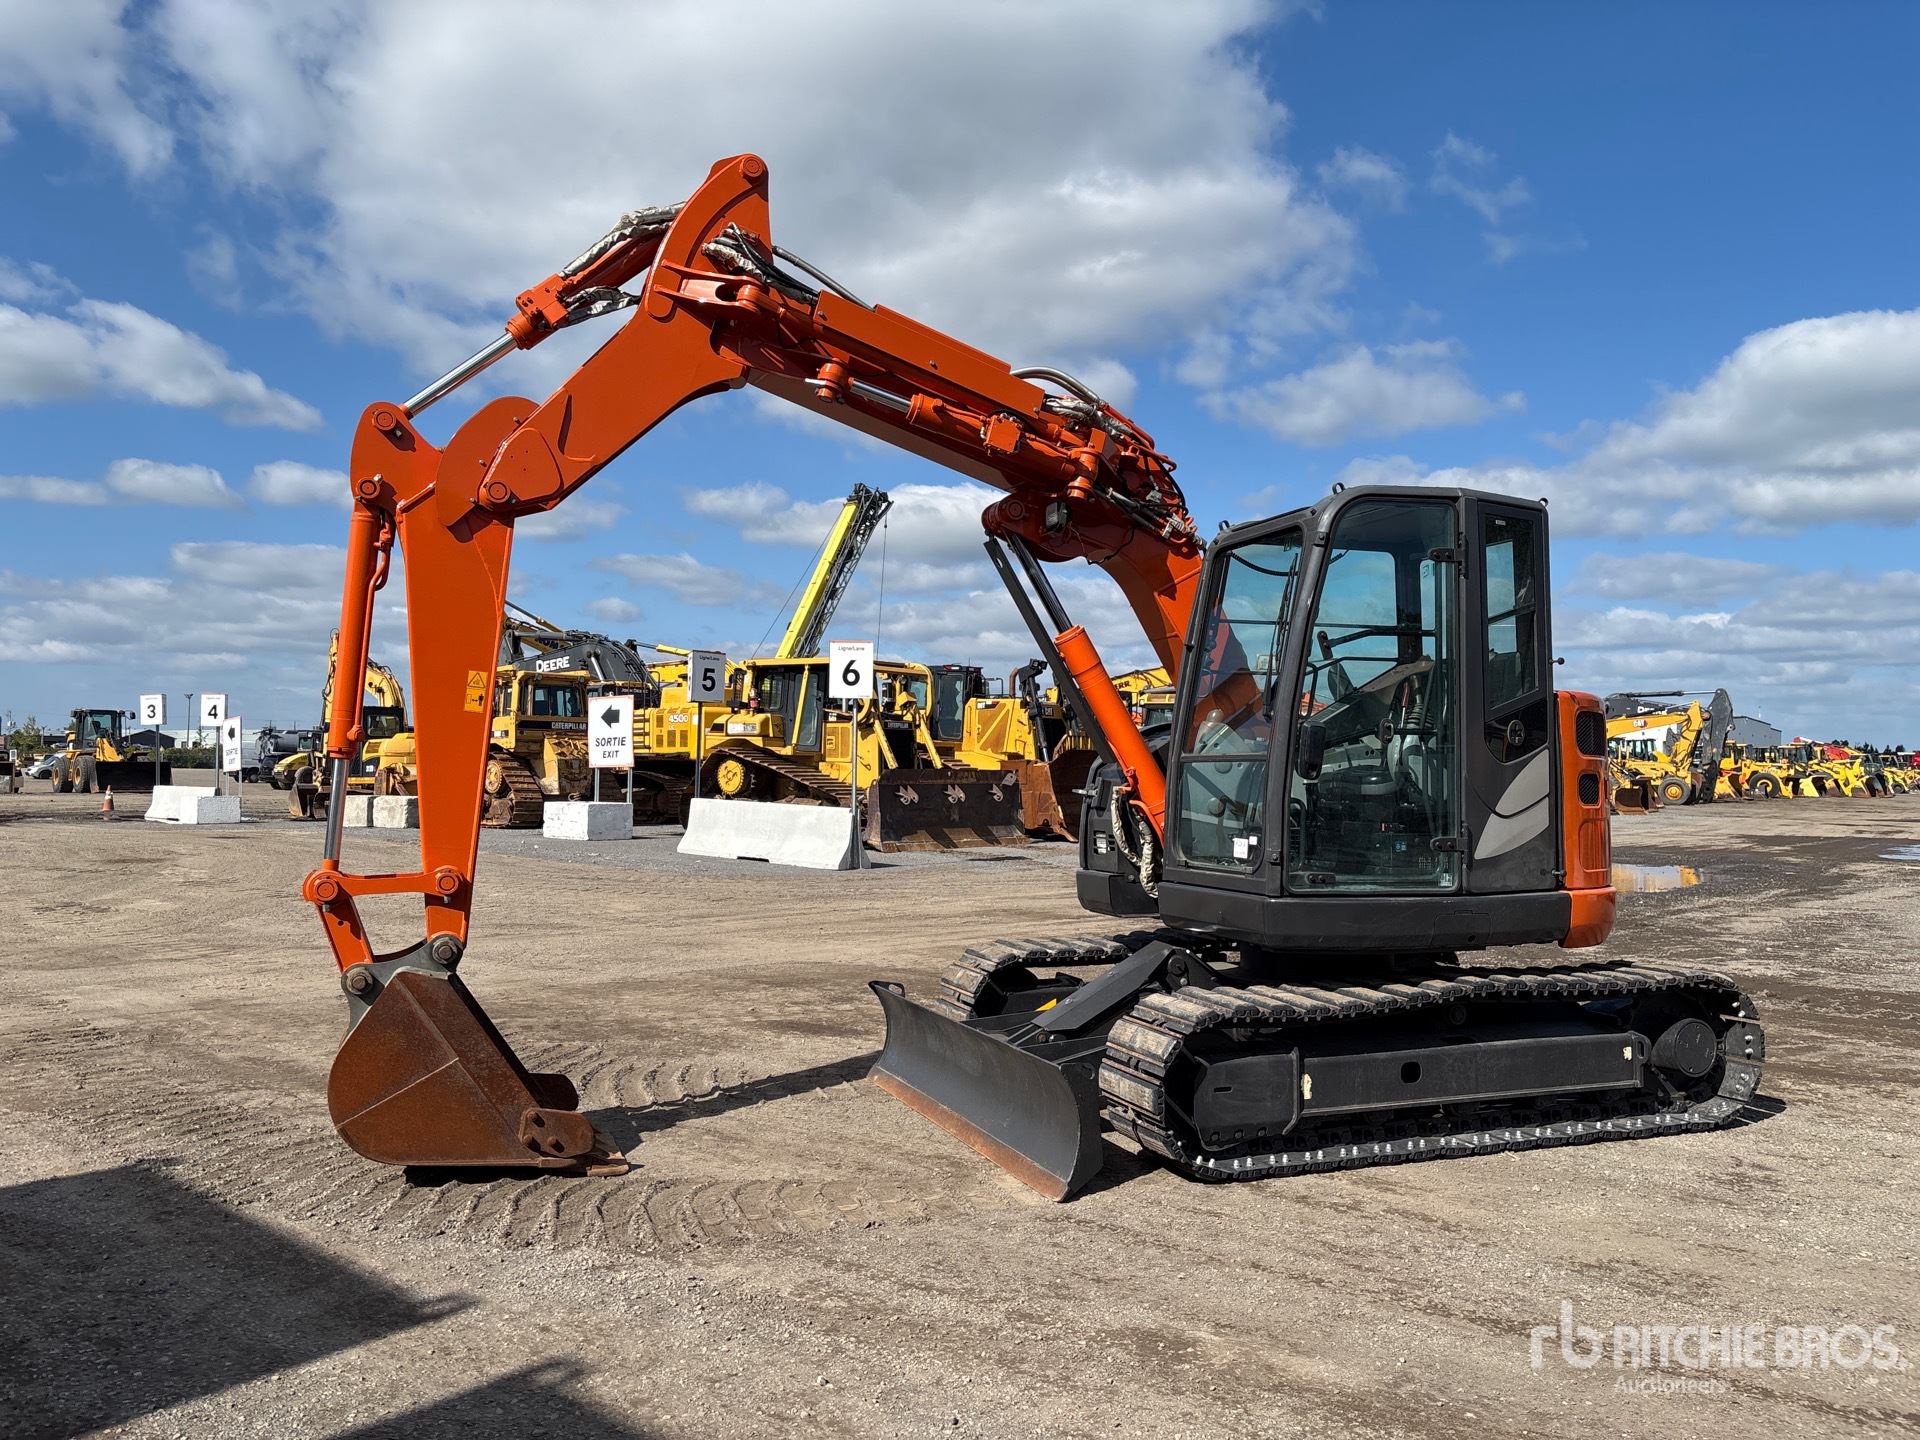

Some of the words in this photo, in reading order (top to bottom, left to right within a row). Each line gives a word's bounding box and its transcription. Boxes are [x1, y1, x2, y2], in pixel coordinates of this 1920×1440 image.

[535, 656, 570, 672] DEERE
[702, 668, 716, 692] 5
[842, 660, 860, 686] 6
[147, 704, 156, 719] 3
[207, 704, 218, 719] 4
[551, 721, 587, 730] CATERPILLAR
[1633, 719, 1645, 727] CAT
[595, 736, 627, 747] SORTIE
[602, 750, 619, 759] EXIT
